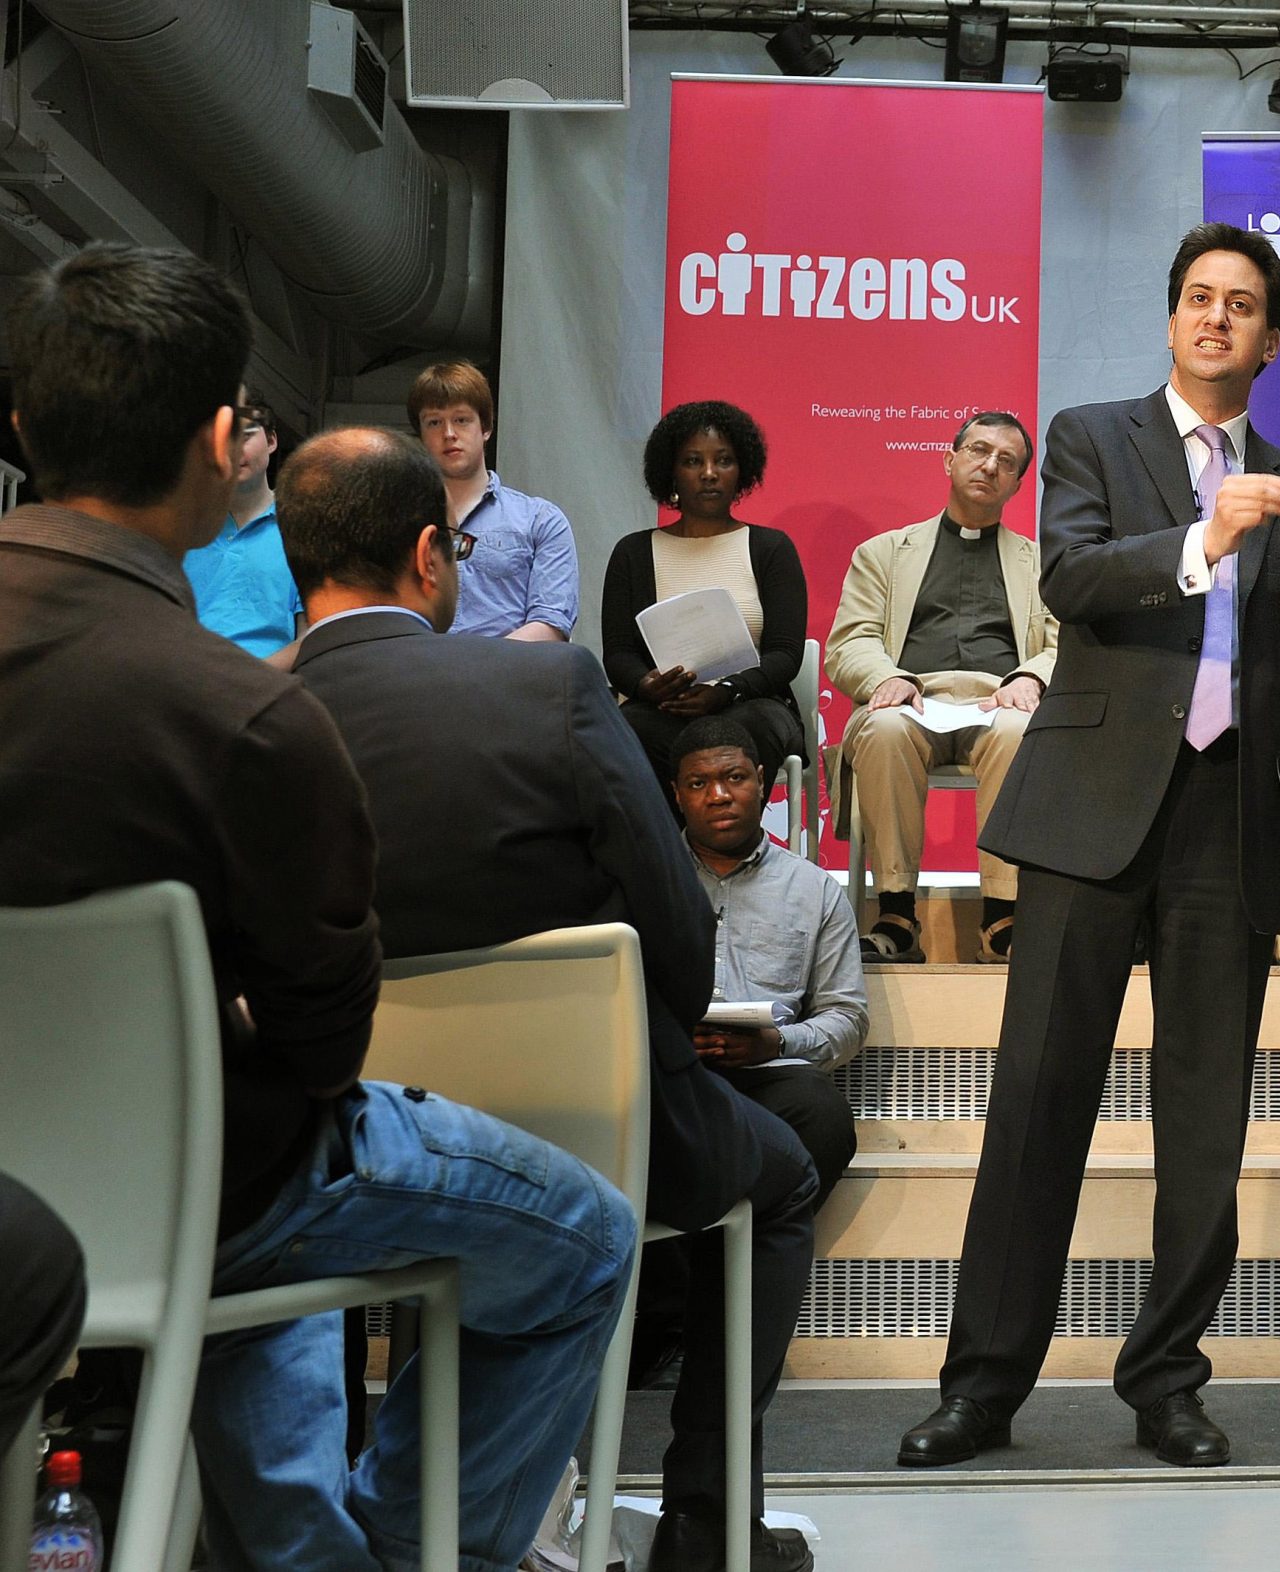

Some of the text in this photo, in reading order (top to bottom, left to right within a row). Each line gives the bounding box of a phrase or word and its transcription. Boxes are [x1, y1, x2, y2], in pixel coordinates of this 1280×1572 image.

[971, 296, 1020, 323] UK
[811, 403, 881, 422] Reweaving
[885, 405, 907, 419] the
[911, 405, 950, 420] Fabric
[953, 406, 969, 420] of
